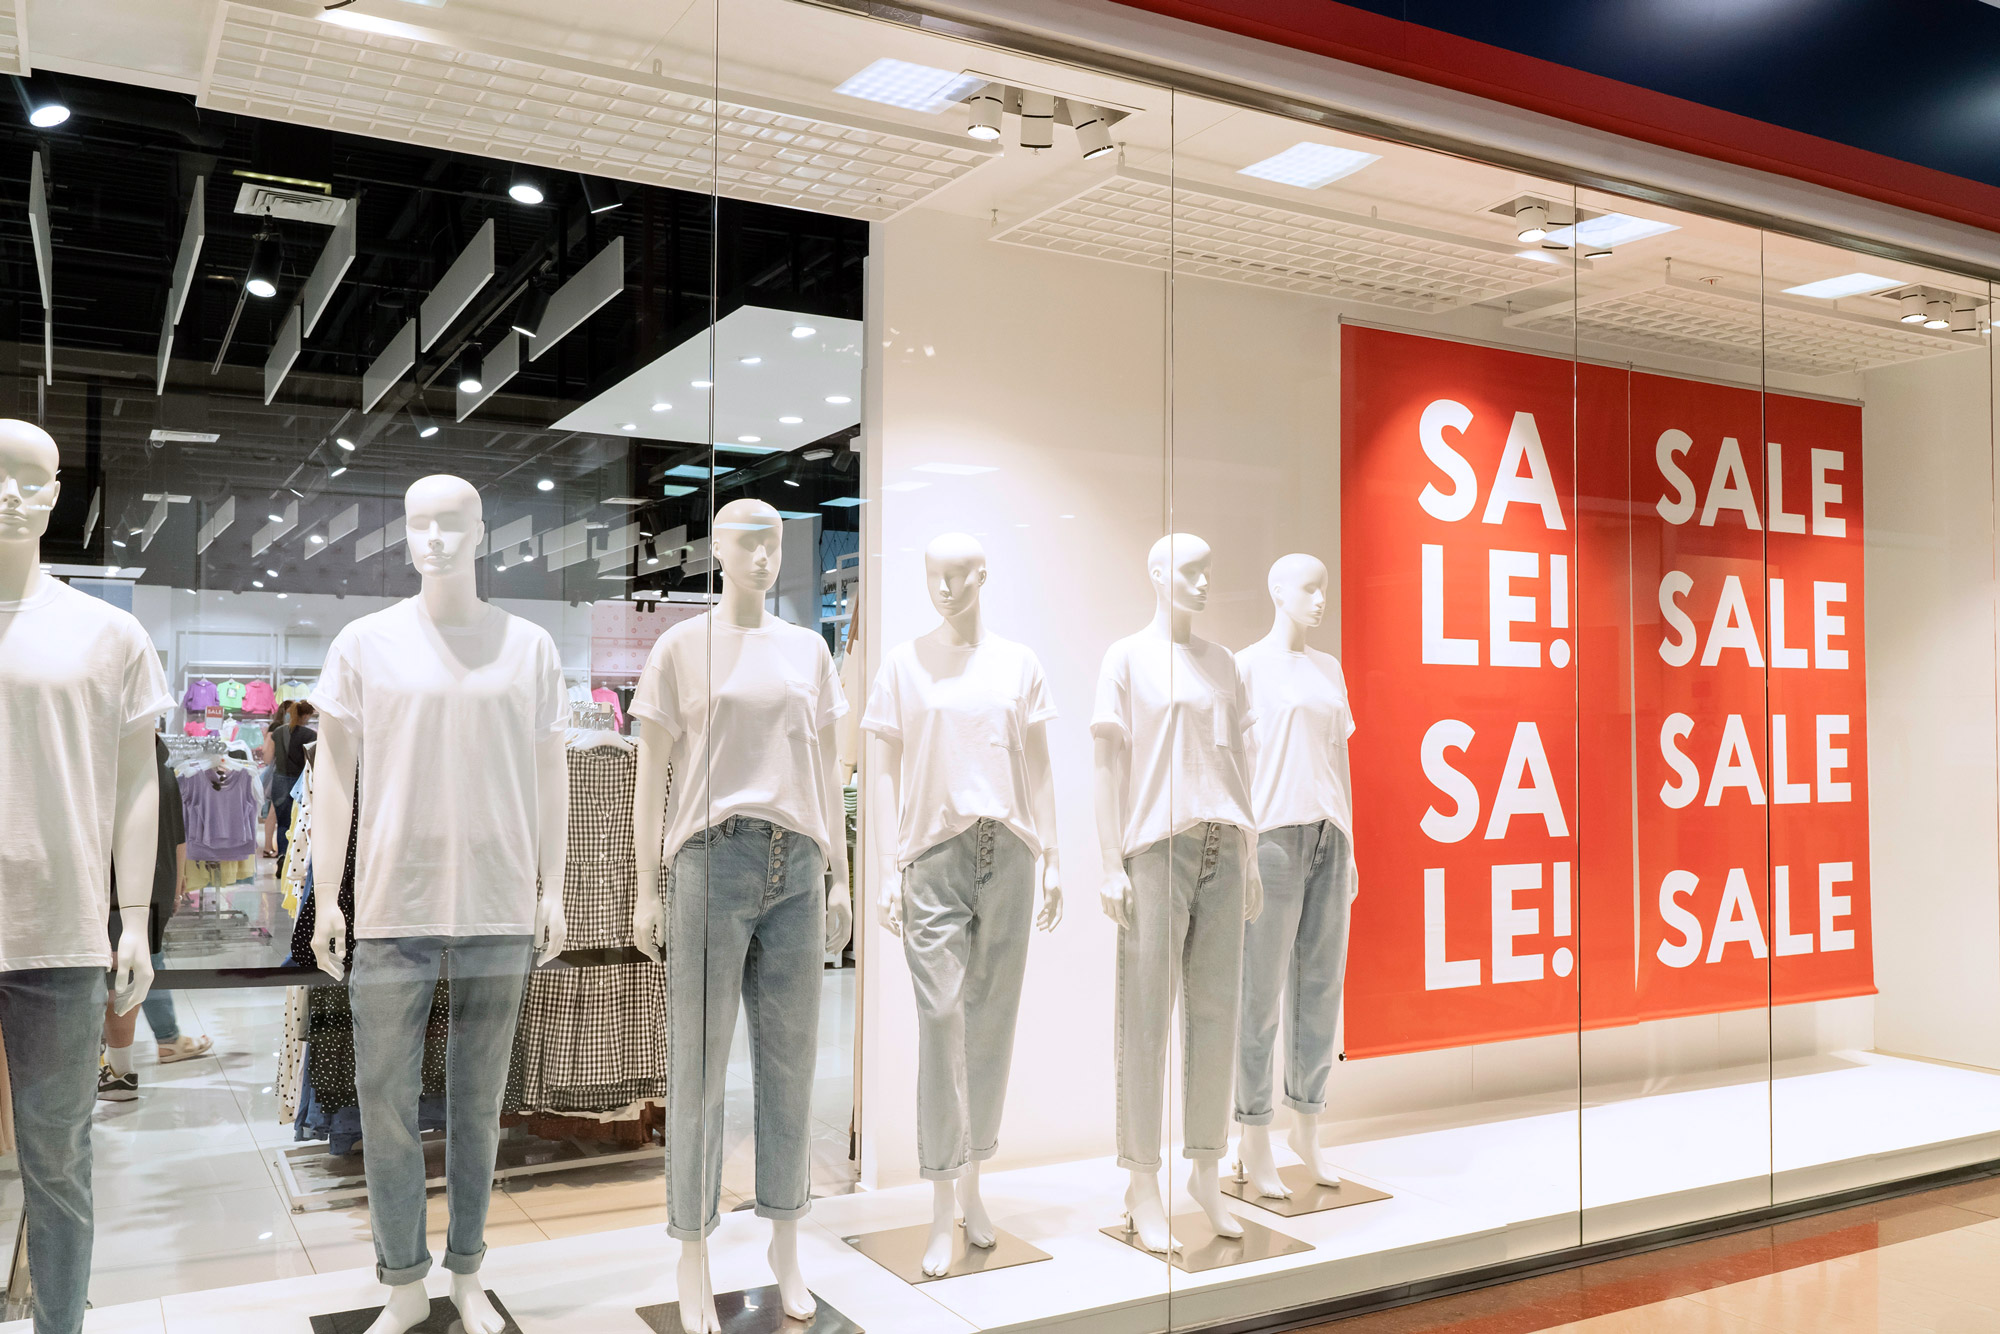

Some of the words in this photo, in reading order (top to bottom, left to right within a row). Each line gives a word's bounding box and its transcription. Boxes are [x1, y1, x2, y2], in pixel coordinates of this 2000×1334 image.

[1417, 398, 1567, 531] SA
[1655, 428, 1847, 538] SALE
[1421, 543, 1571, 669] LE!
[1658, 570, 1849, 670] SALE
[1419, 718, 1570, 844] SA
[1659, 712, 1852, 809] SALE
[1423, 861, 1574, 992] LE!
[1656, 861, 1855, 969] SALE
